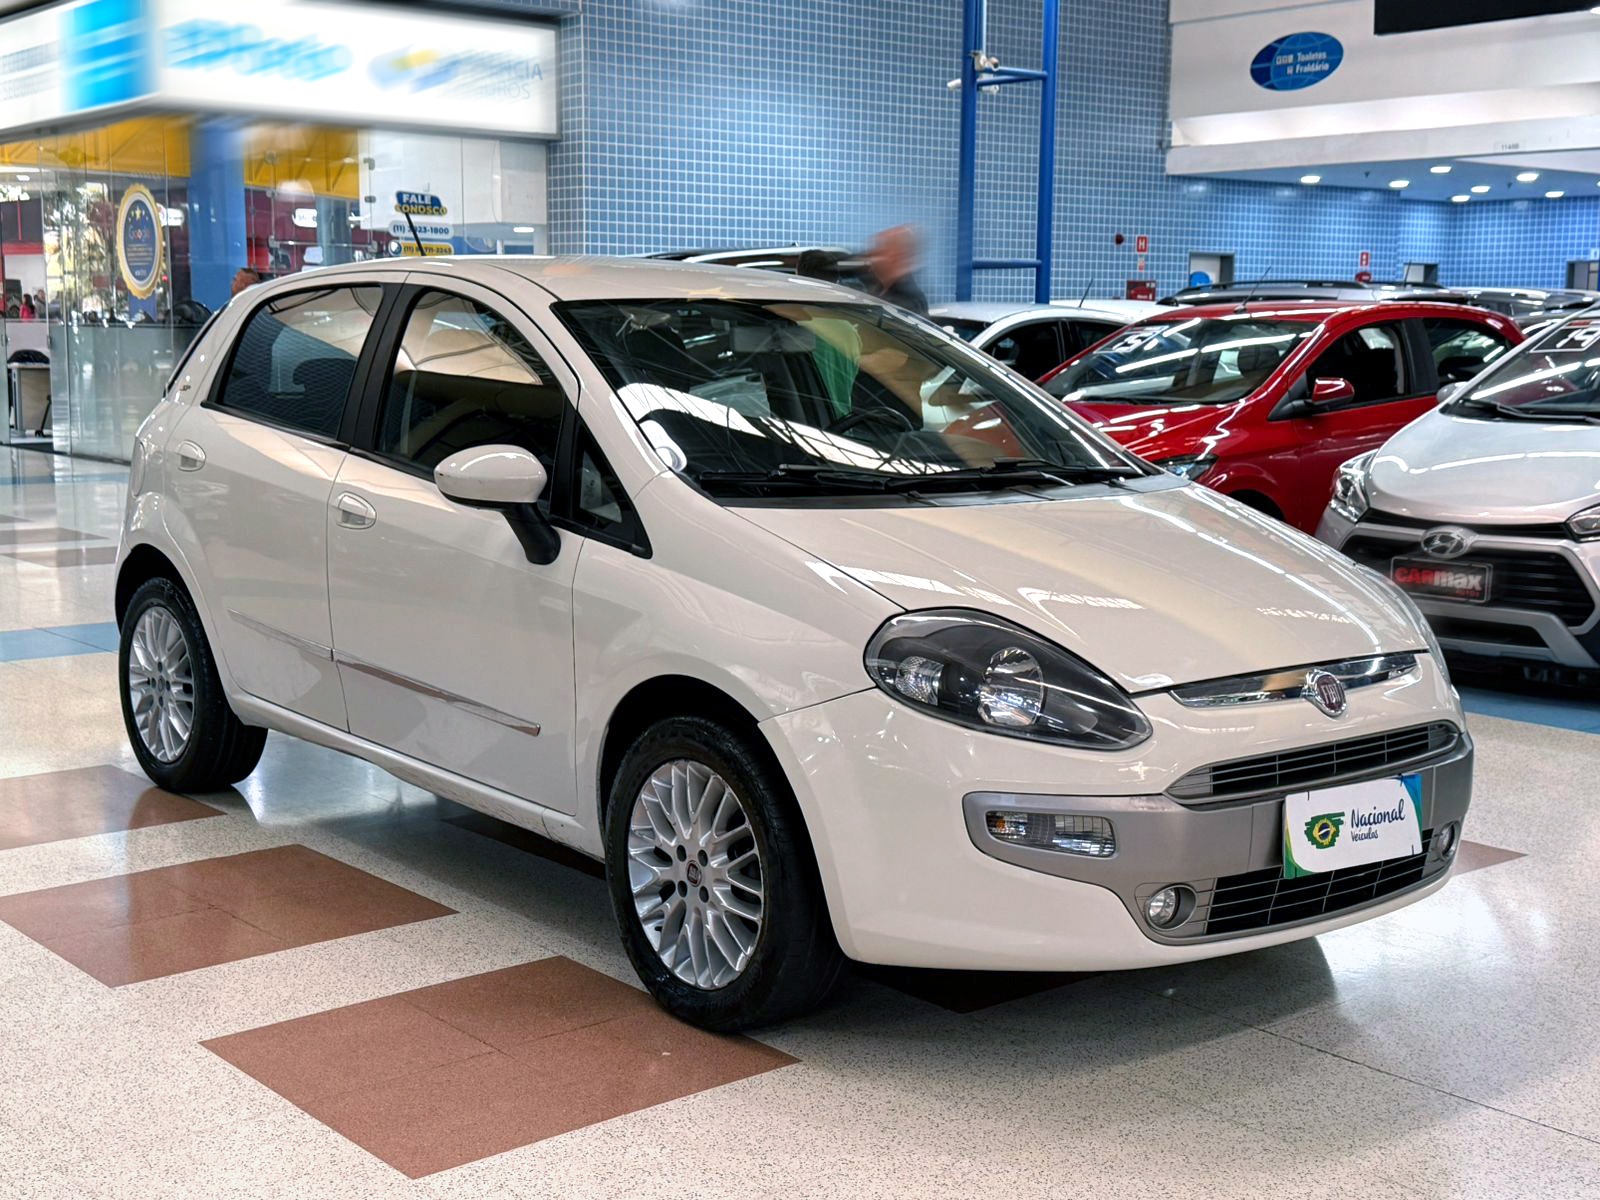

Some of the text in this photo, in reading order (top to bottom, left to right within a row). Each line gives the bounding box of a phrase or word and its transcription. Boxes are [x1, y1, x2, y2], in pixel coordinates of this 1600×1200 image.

[402, 193, 431, 204] FALE
[394, 205, 448, 215] CONOSCO
[1350, 798, 1406, 829] Nacional
